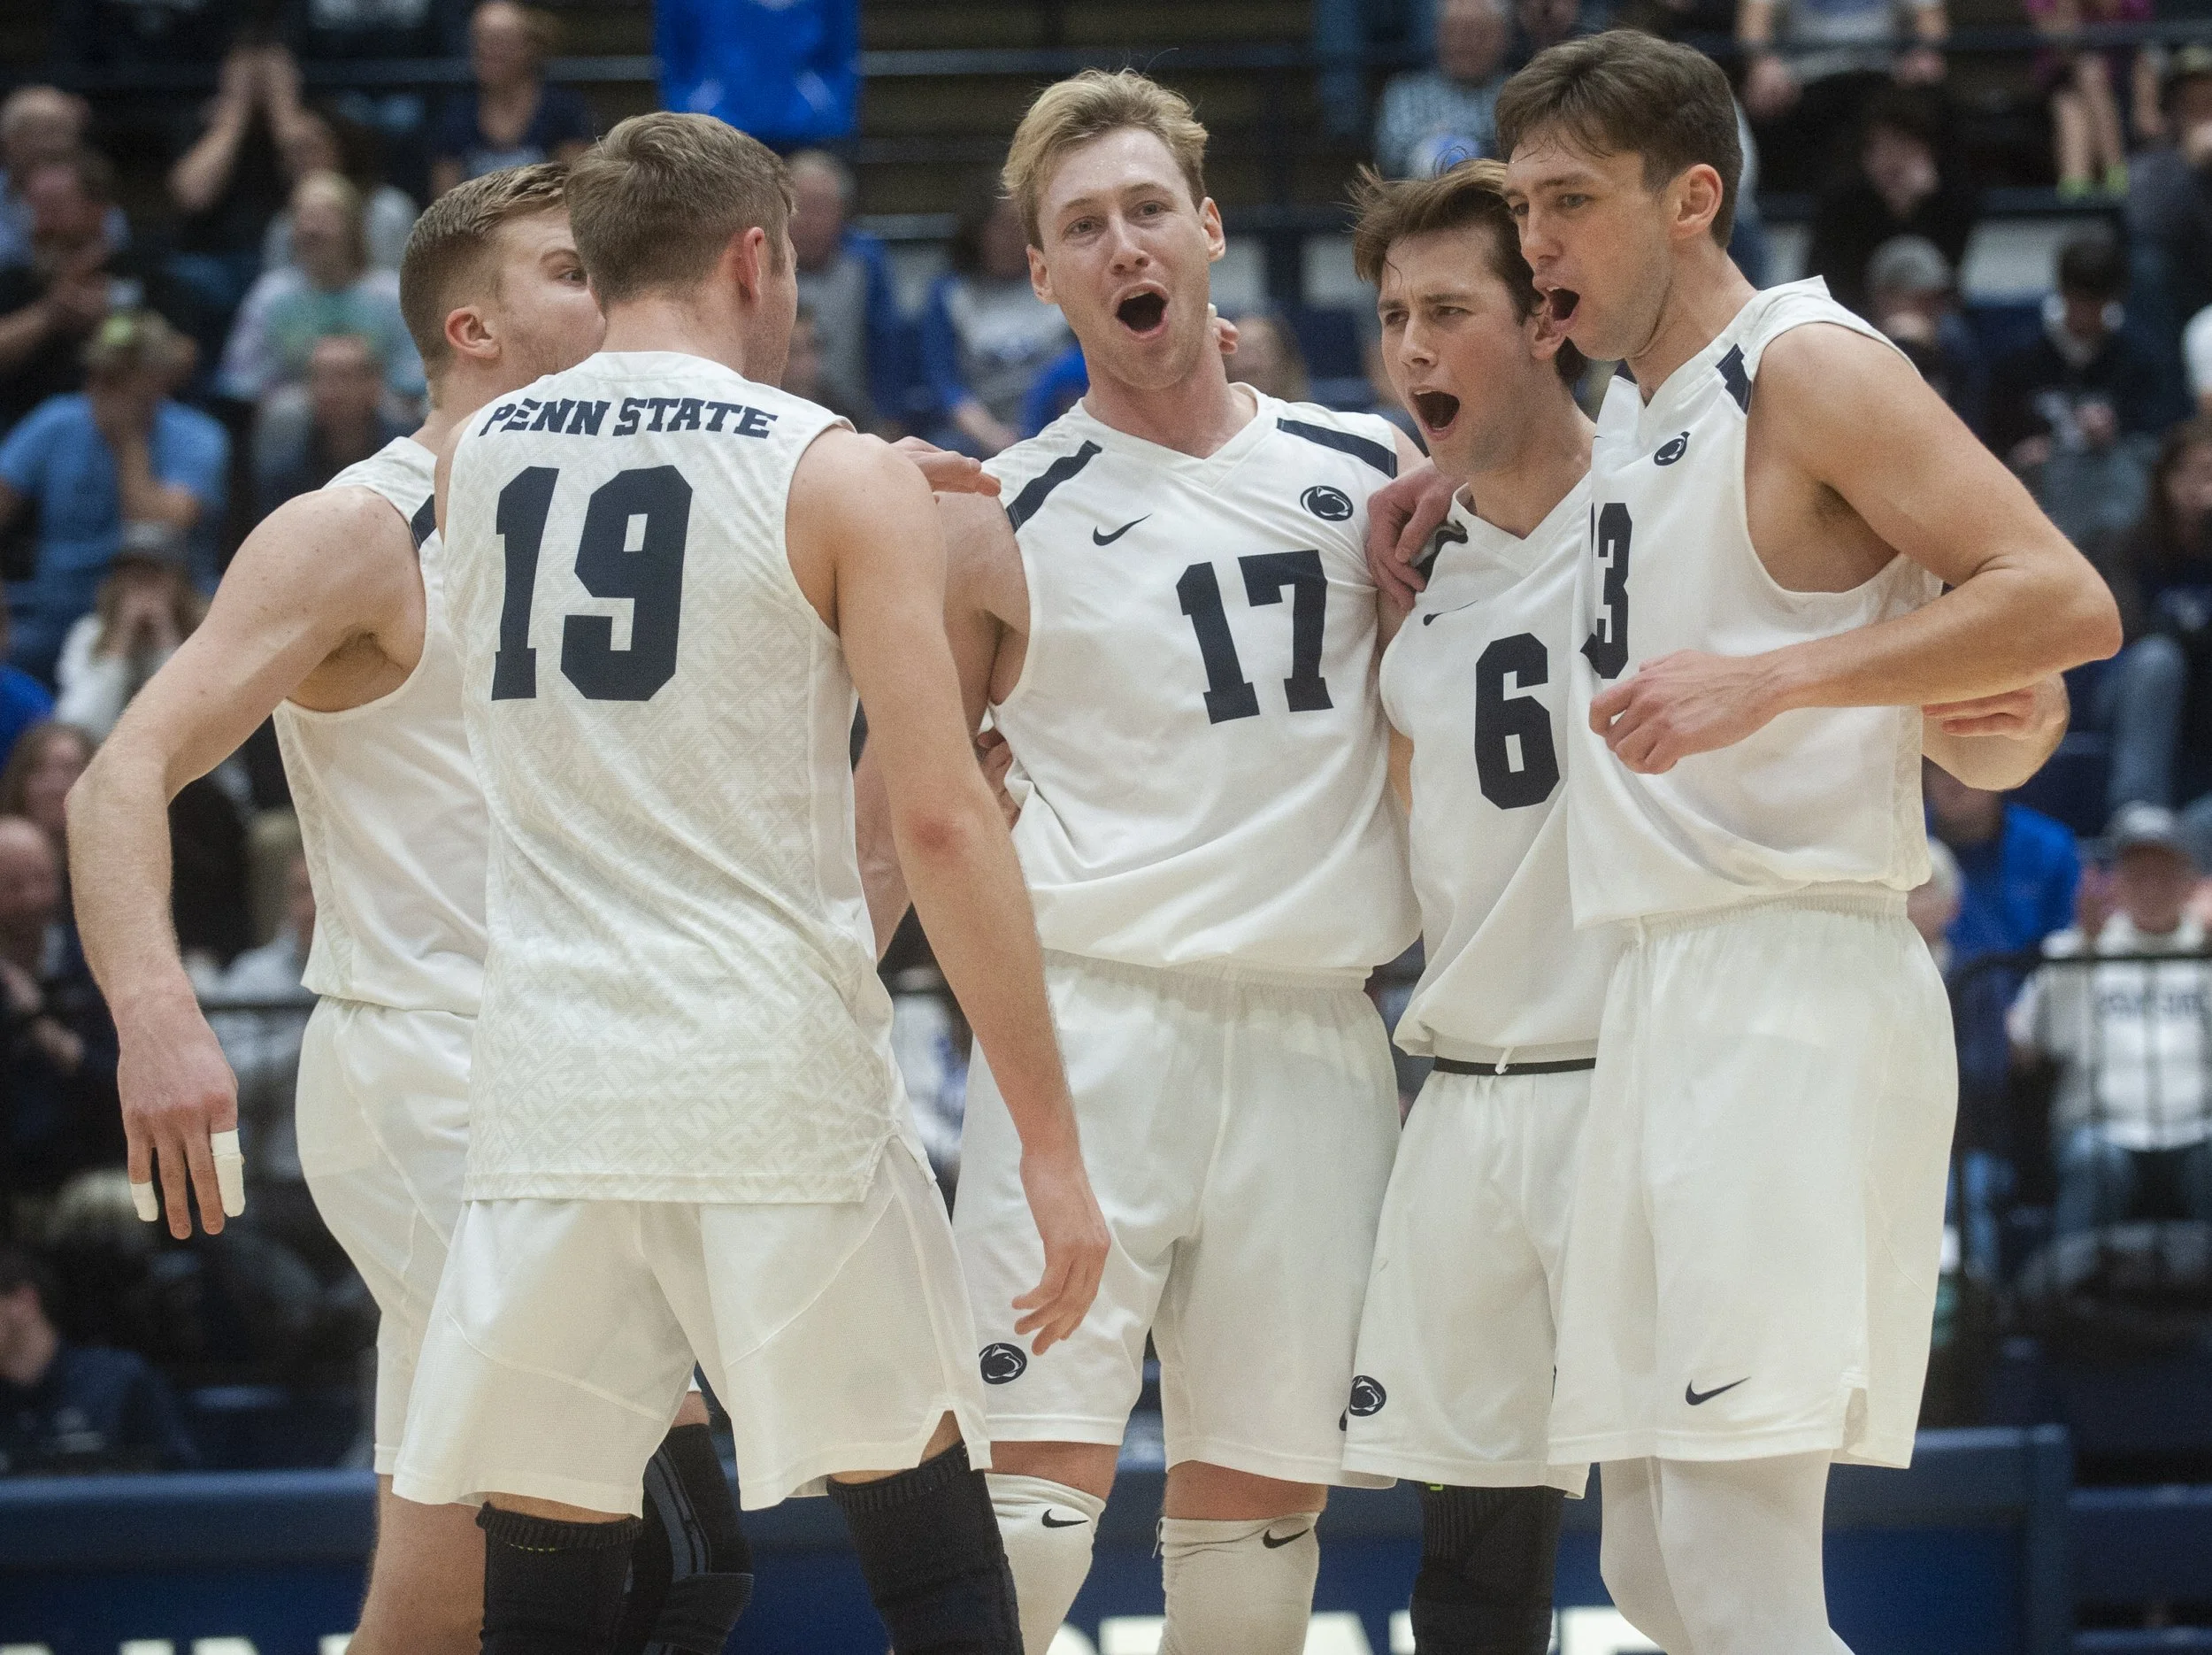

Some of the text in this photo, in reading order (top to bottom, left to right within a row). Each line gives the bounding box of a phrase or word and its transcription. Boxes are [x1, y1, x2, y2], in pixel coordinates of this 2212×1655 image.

[479, 397, 779, 439] PENN STATE
[491, 465, 694, 702] 19
[1176, 549, 1334, 725] 17
[1580, 502, 1632, 680] 3
[1474, 632, 1561, 811] 6
